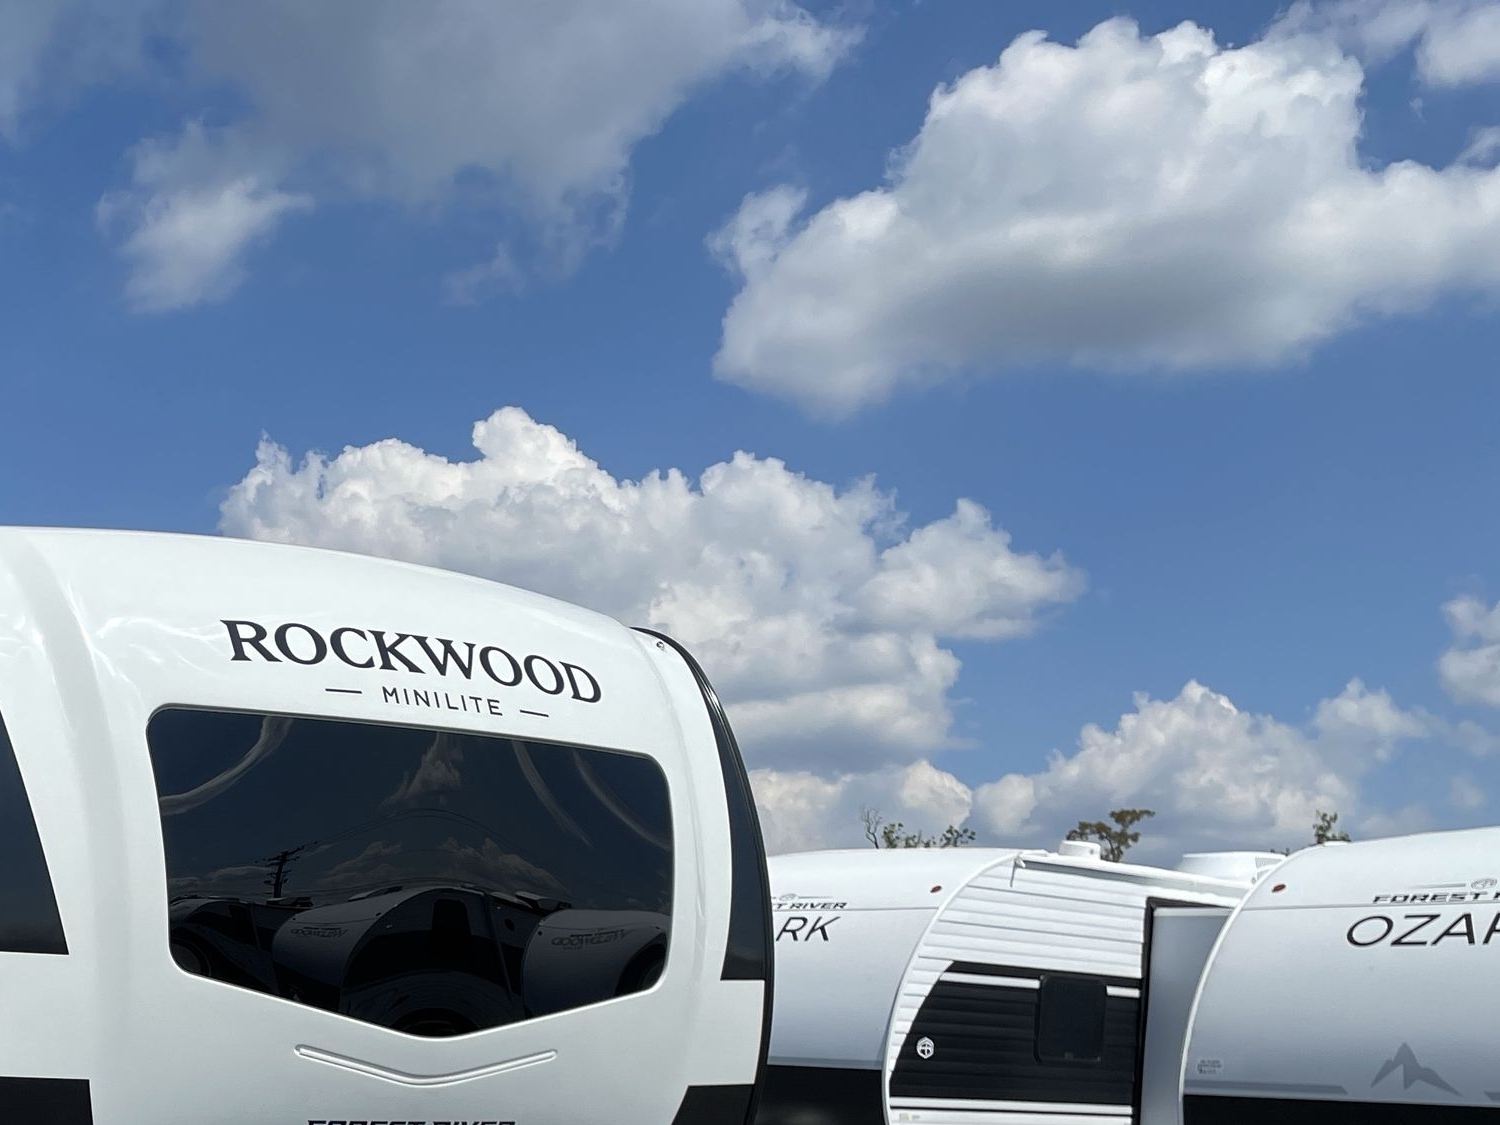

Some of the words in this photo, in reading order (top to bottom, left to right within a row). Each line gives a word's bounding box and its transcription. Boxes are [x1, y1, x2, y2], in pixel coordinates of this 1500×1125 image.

[220, 619, 602, 704] ROCKWOOD
[382, 685, 503, 716] MINILITE
[1373, 891, 1487, 903] FOREST
